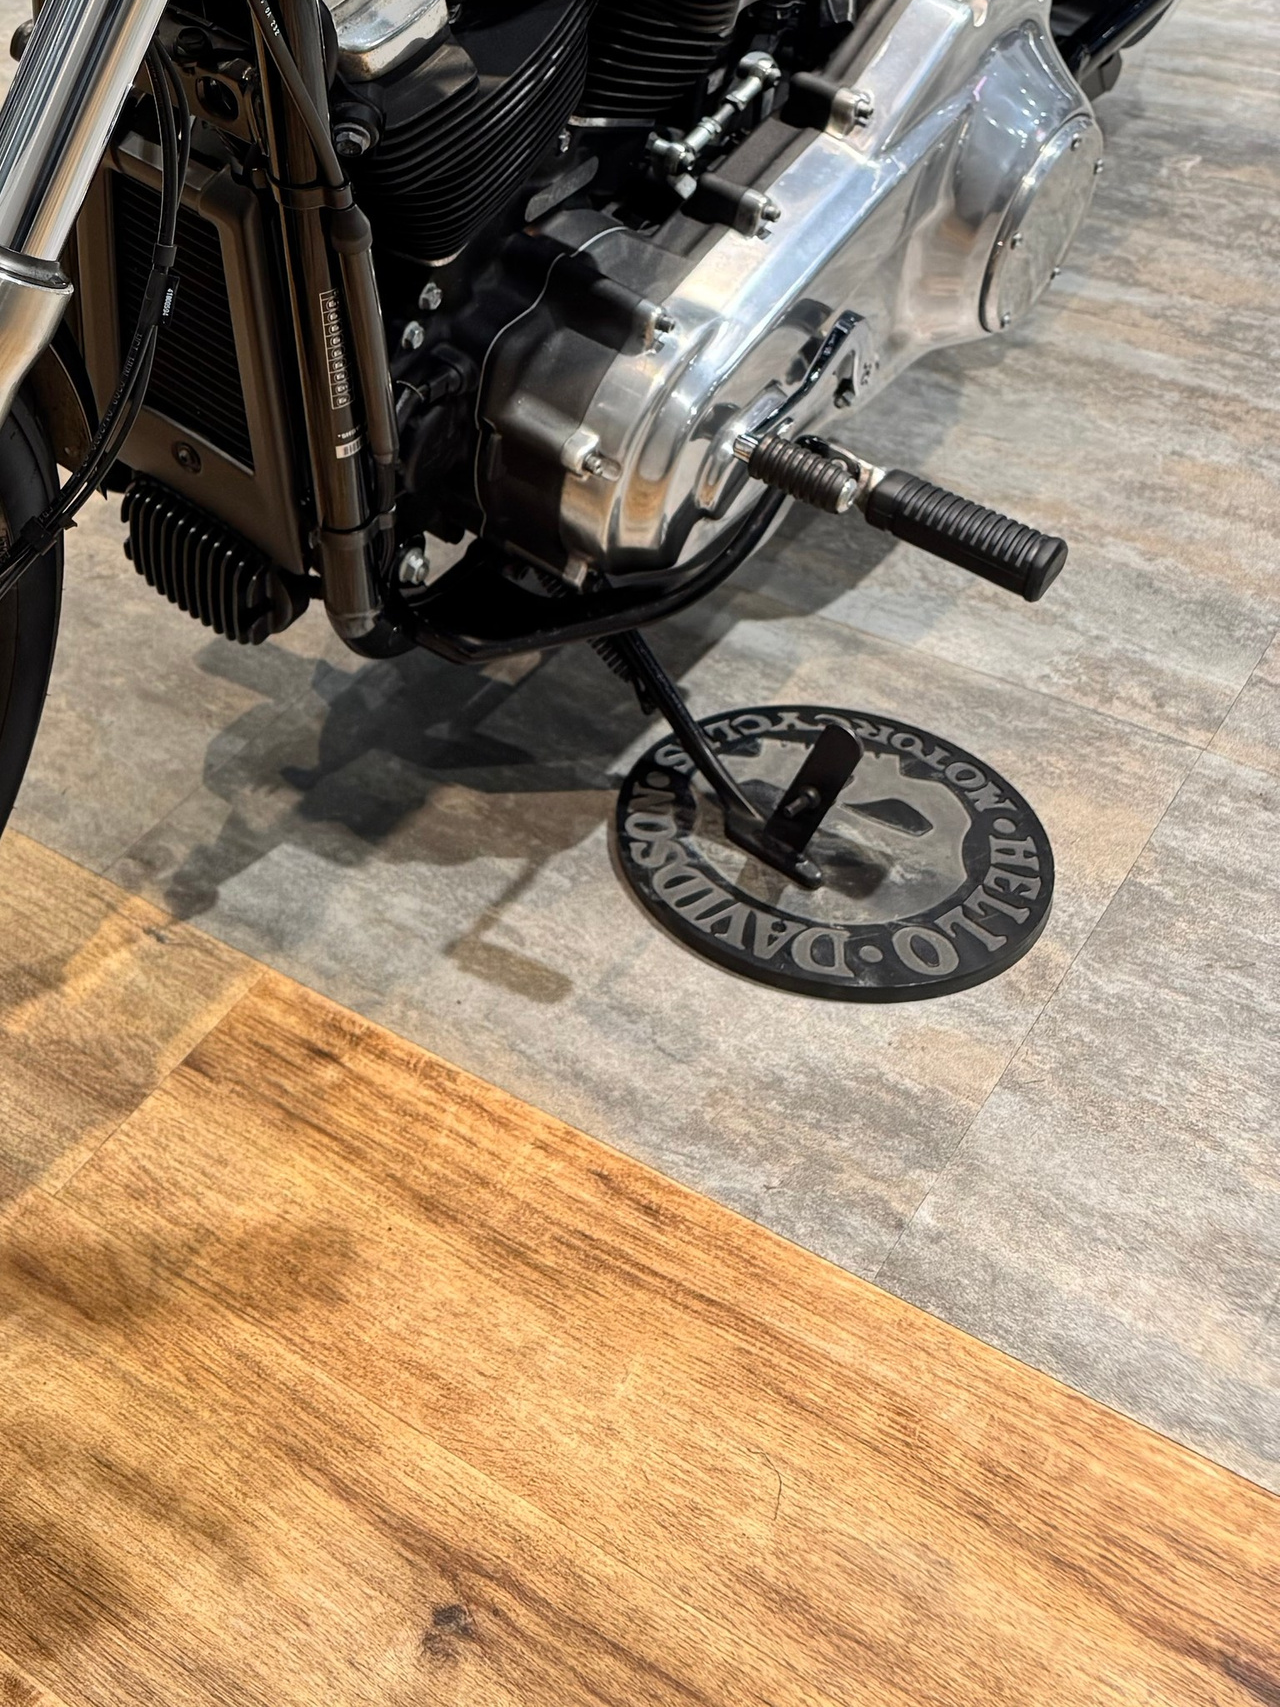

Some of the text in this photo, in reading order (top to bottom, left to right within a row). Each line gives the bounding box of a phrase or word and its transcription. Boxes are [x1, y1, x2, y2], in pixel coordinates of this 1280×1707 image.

[625, 711, 1042, 978] HELLO DAVIDSON MOTORCYCLS
